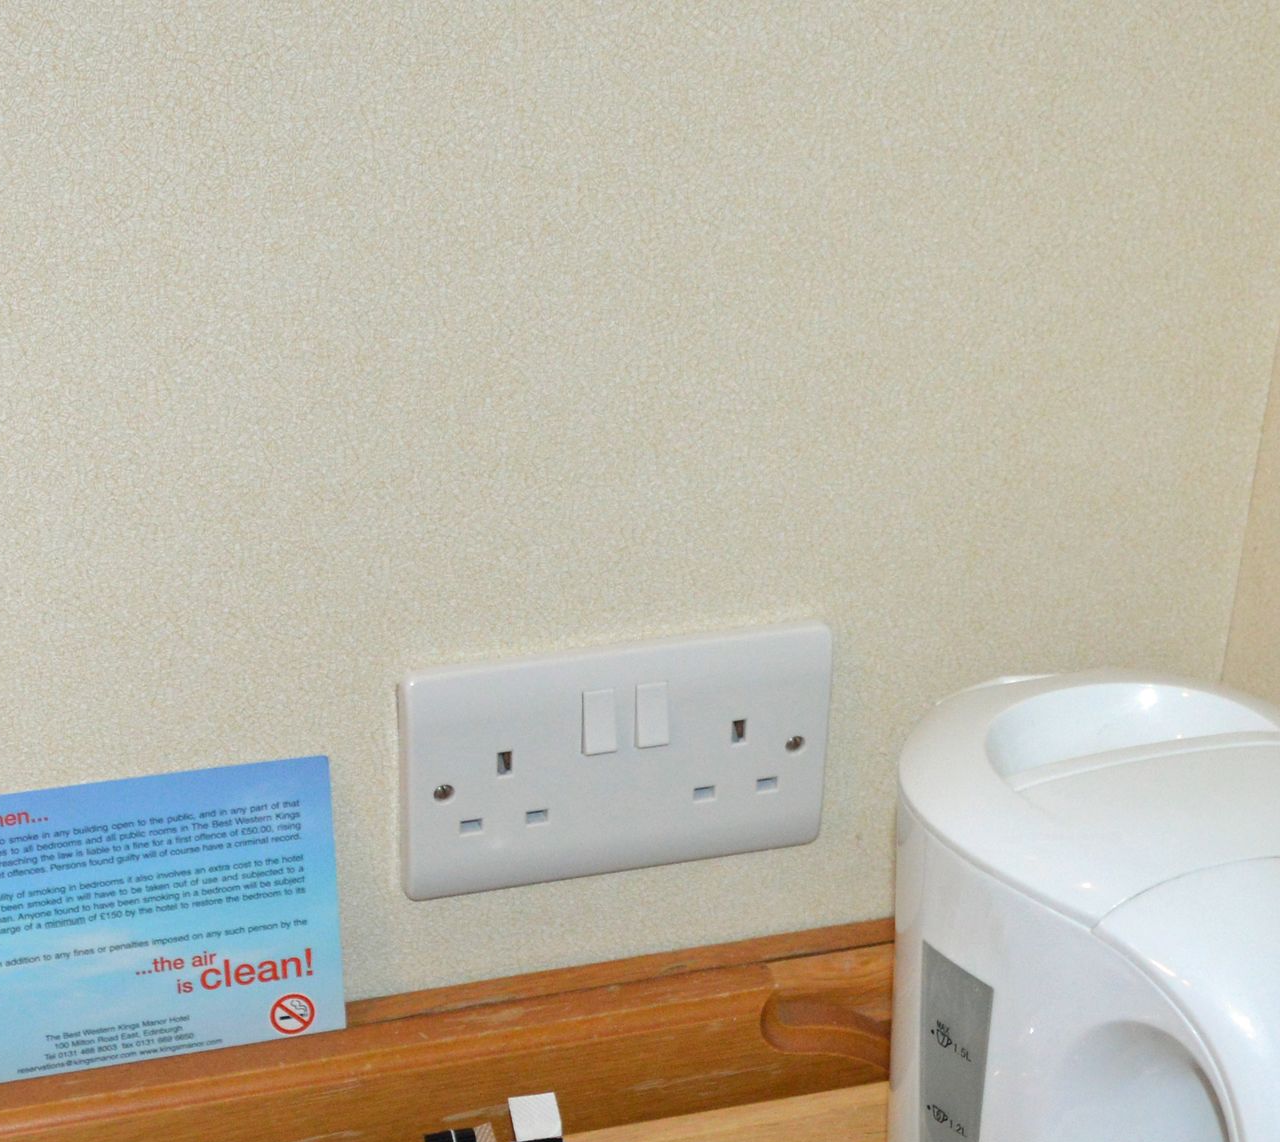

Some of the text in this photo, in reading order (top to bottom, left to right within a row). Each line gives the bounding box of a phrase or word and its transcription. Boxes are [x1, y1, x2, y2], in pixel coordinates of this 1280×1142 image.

[8, 832, 39, 844] smoke
[41, 831, 50, 839] in
[52, 829, 70, 838] any
[72, 824, 109, 836] building
[110, 821, 136, 830] open
[136, 818, 146, 826] to
[148, 816, 163, 825] the
[166, 813, 195, 824] public,
[198, 809, 216, 819] and
[218, 808, 227, 816] in
[229, 806, 247, 815] any
[249, 803, 267, 813] part
[270, 801, 279, 810] of
[282, 799, 299, 808] that
[134, 953, 215, 976] ...the air
[177, 947, 313, 992] is clean!
